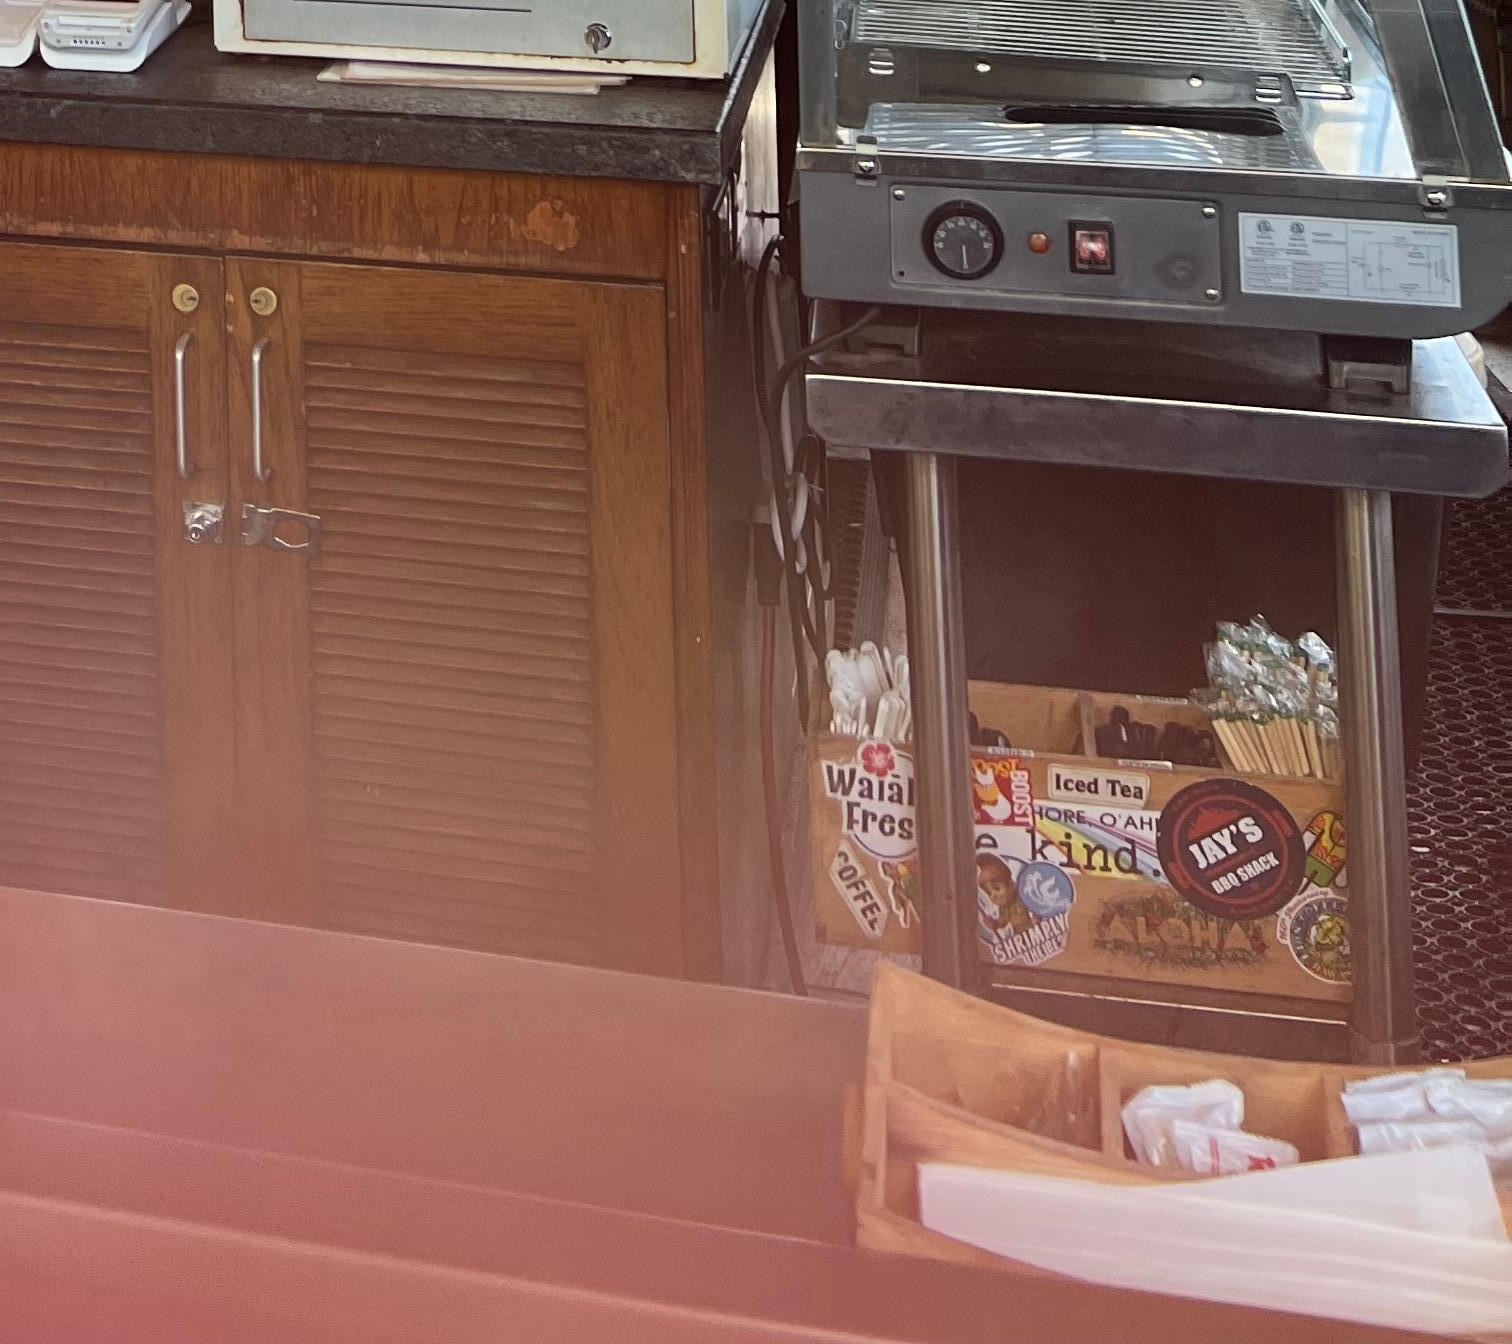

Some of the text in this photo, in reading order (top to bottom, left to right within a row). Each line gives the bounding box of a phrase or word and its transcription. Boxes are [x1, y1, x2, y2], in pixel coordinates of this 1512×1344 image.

[1054, 773, 1144, 801] Iced Tea
[846, 800, 914, 841] Fres
[1188, 816, 1264, 870] JAY'S
[1026, 827, 1162, 878] kind.
[995, 913, 1068, 963] SHRIMPLY
[1102, 913, 1254, 953] ALOHA
